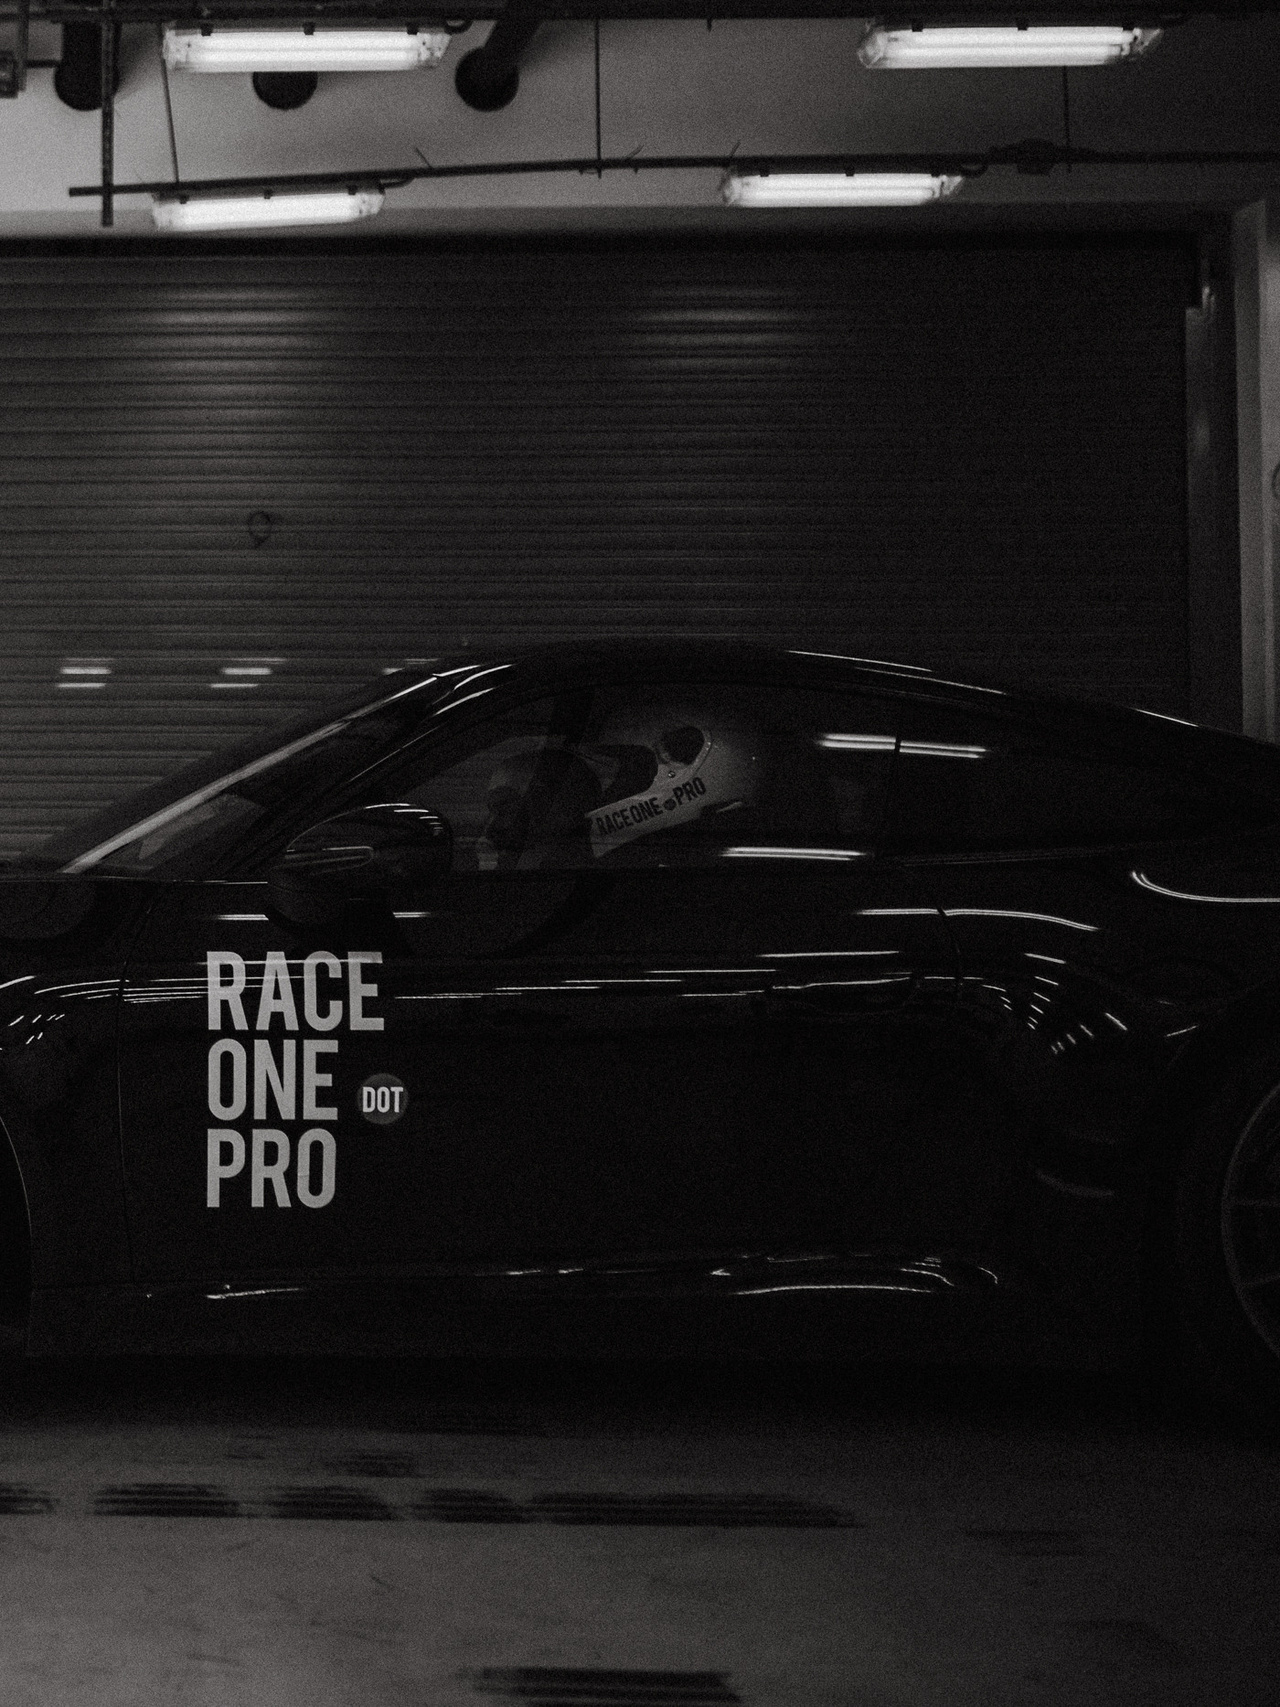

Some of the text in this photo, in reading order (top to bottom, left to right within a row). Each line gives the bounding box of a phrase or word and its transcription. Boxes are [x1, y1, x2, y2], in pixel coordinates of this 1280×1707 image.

[672, 777, 706, 806] PRO
[206, 950, 385, 1031] RACE
[207, 1038, 339, 1121] ONE
[362, 1086, 404, 1114] DOT
[206, 1128, 337, 1209] PRO
